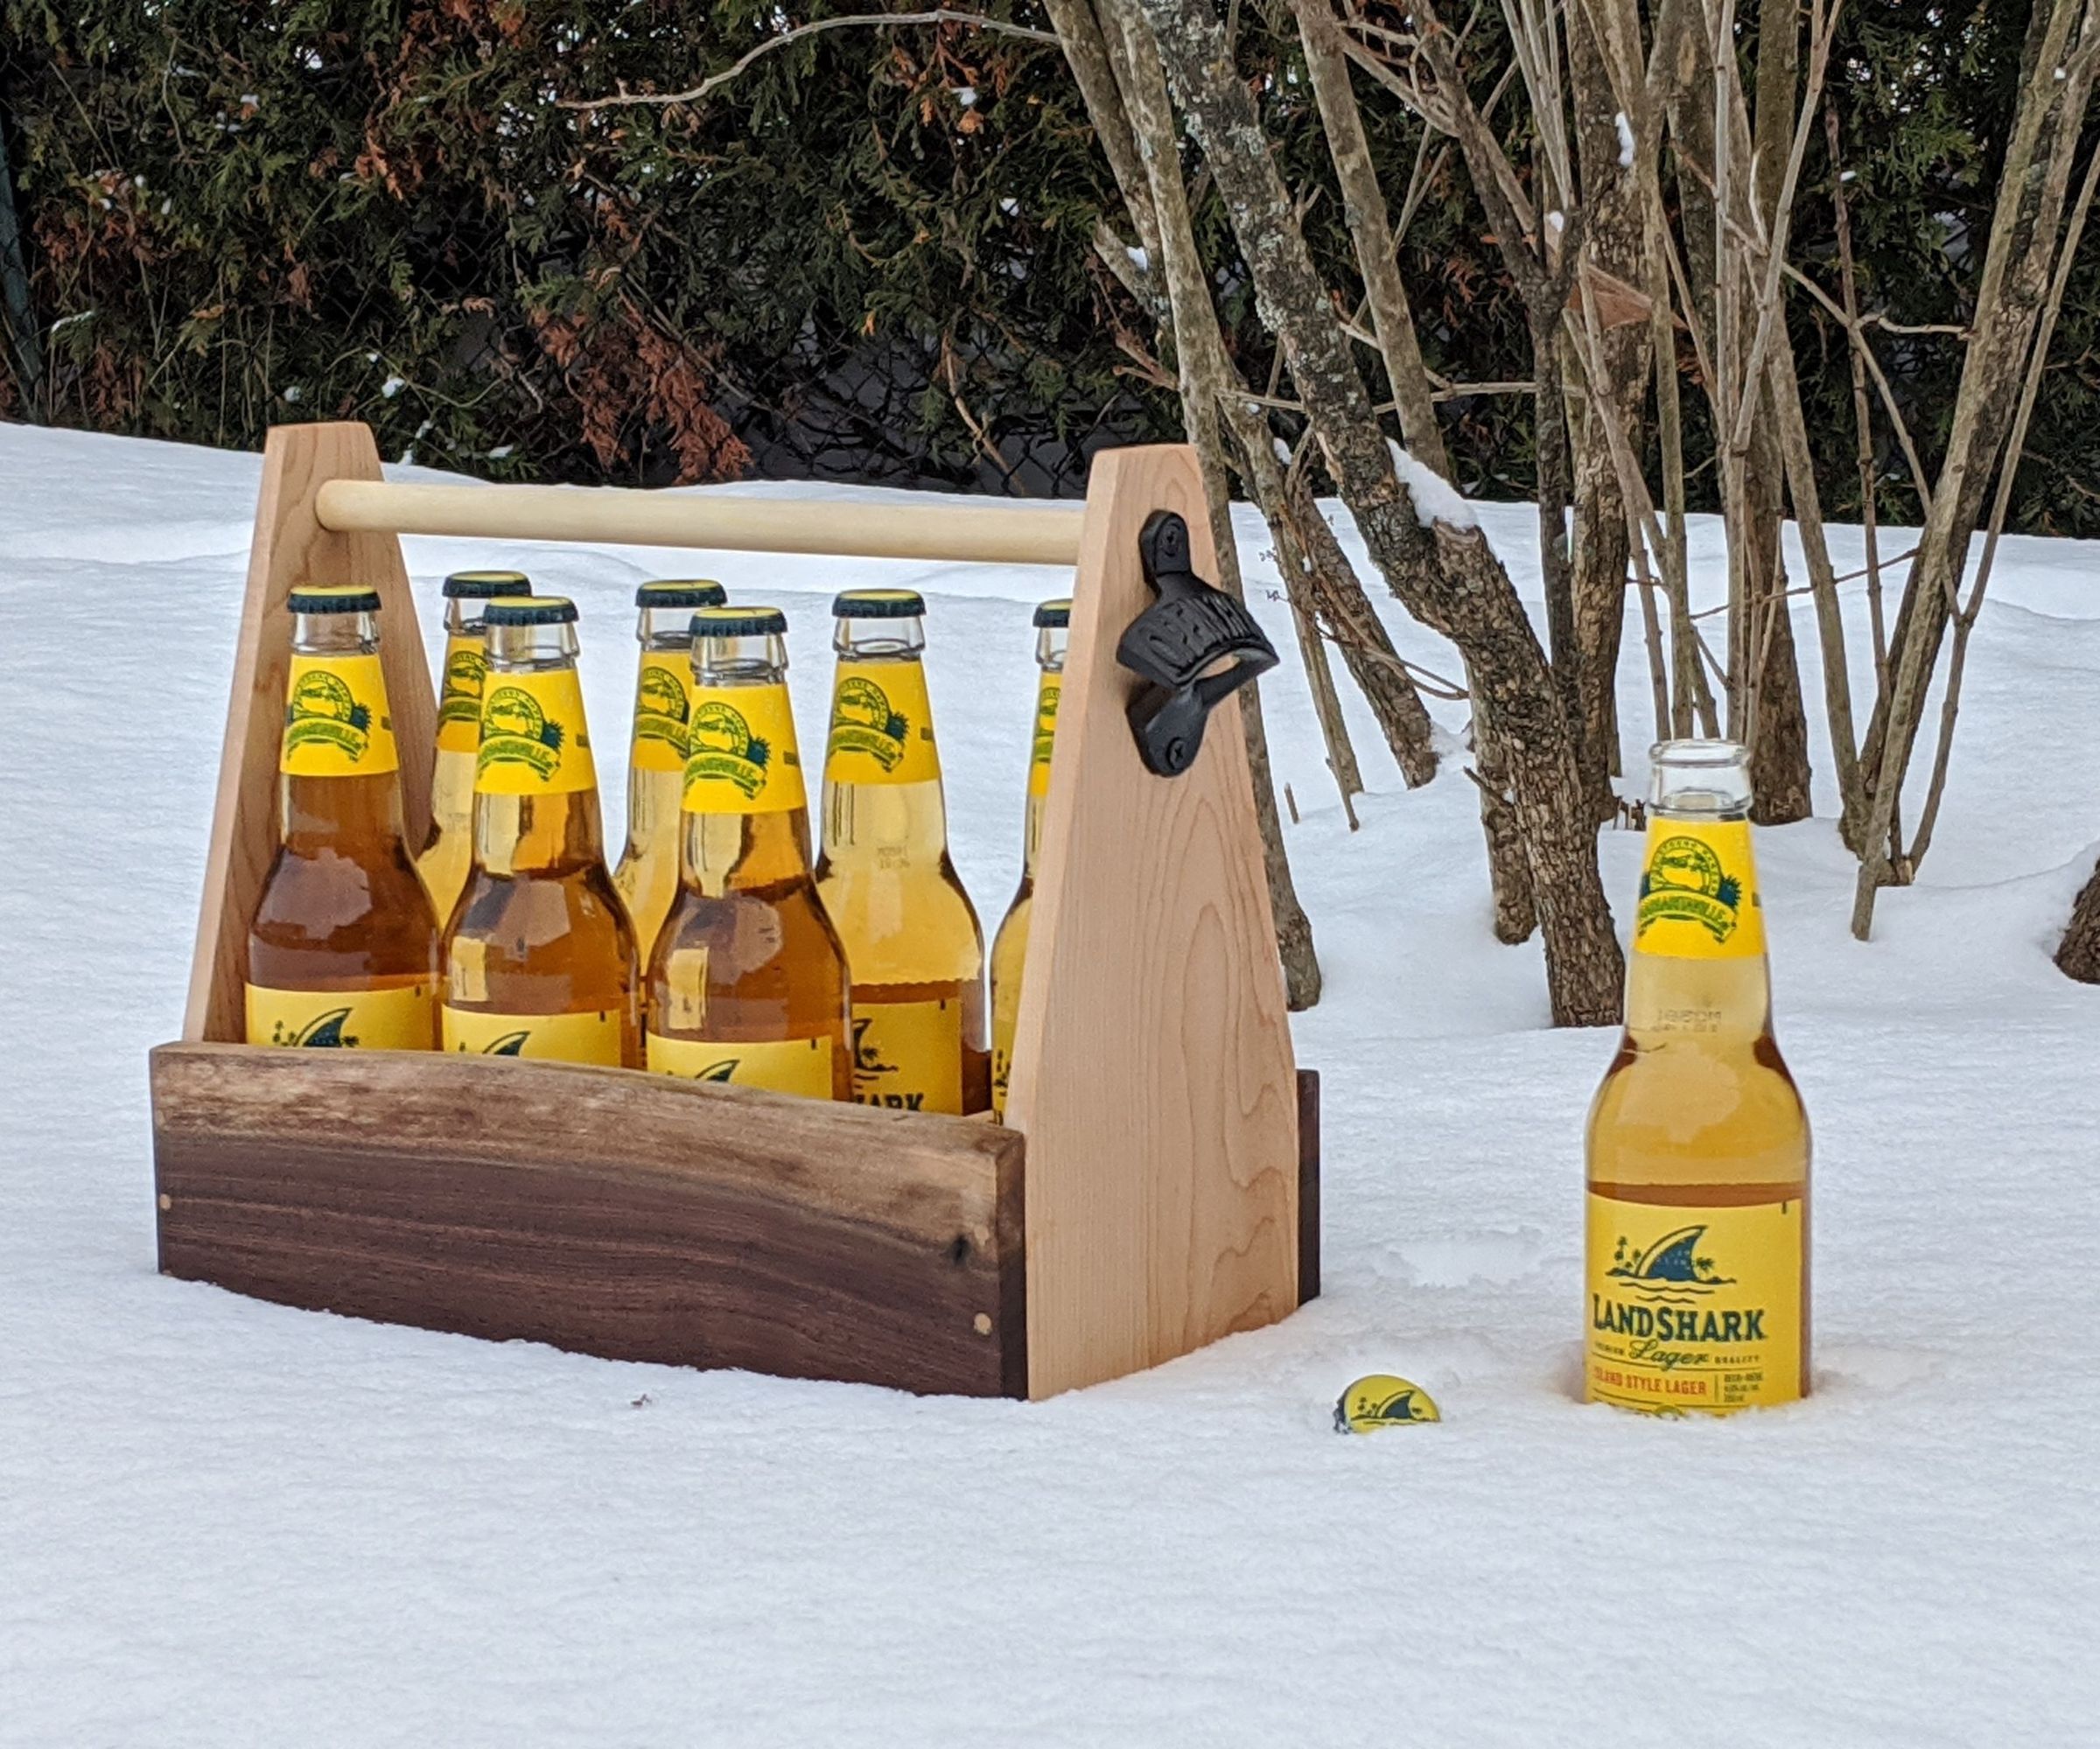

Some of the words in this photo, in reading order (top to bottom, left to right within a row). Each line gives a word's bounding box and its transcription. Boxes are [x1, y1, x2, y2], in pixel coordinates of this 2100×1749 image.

[1592, 1293, 1768, 1342] LANDSHARK
[1628, 1339, 1709, 1371] Lager
[1626, 1375, 1662, 1393] STYLE
[1665, 1380, 1707, 1396] LAGER
